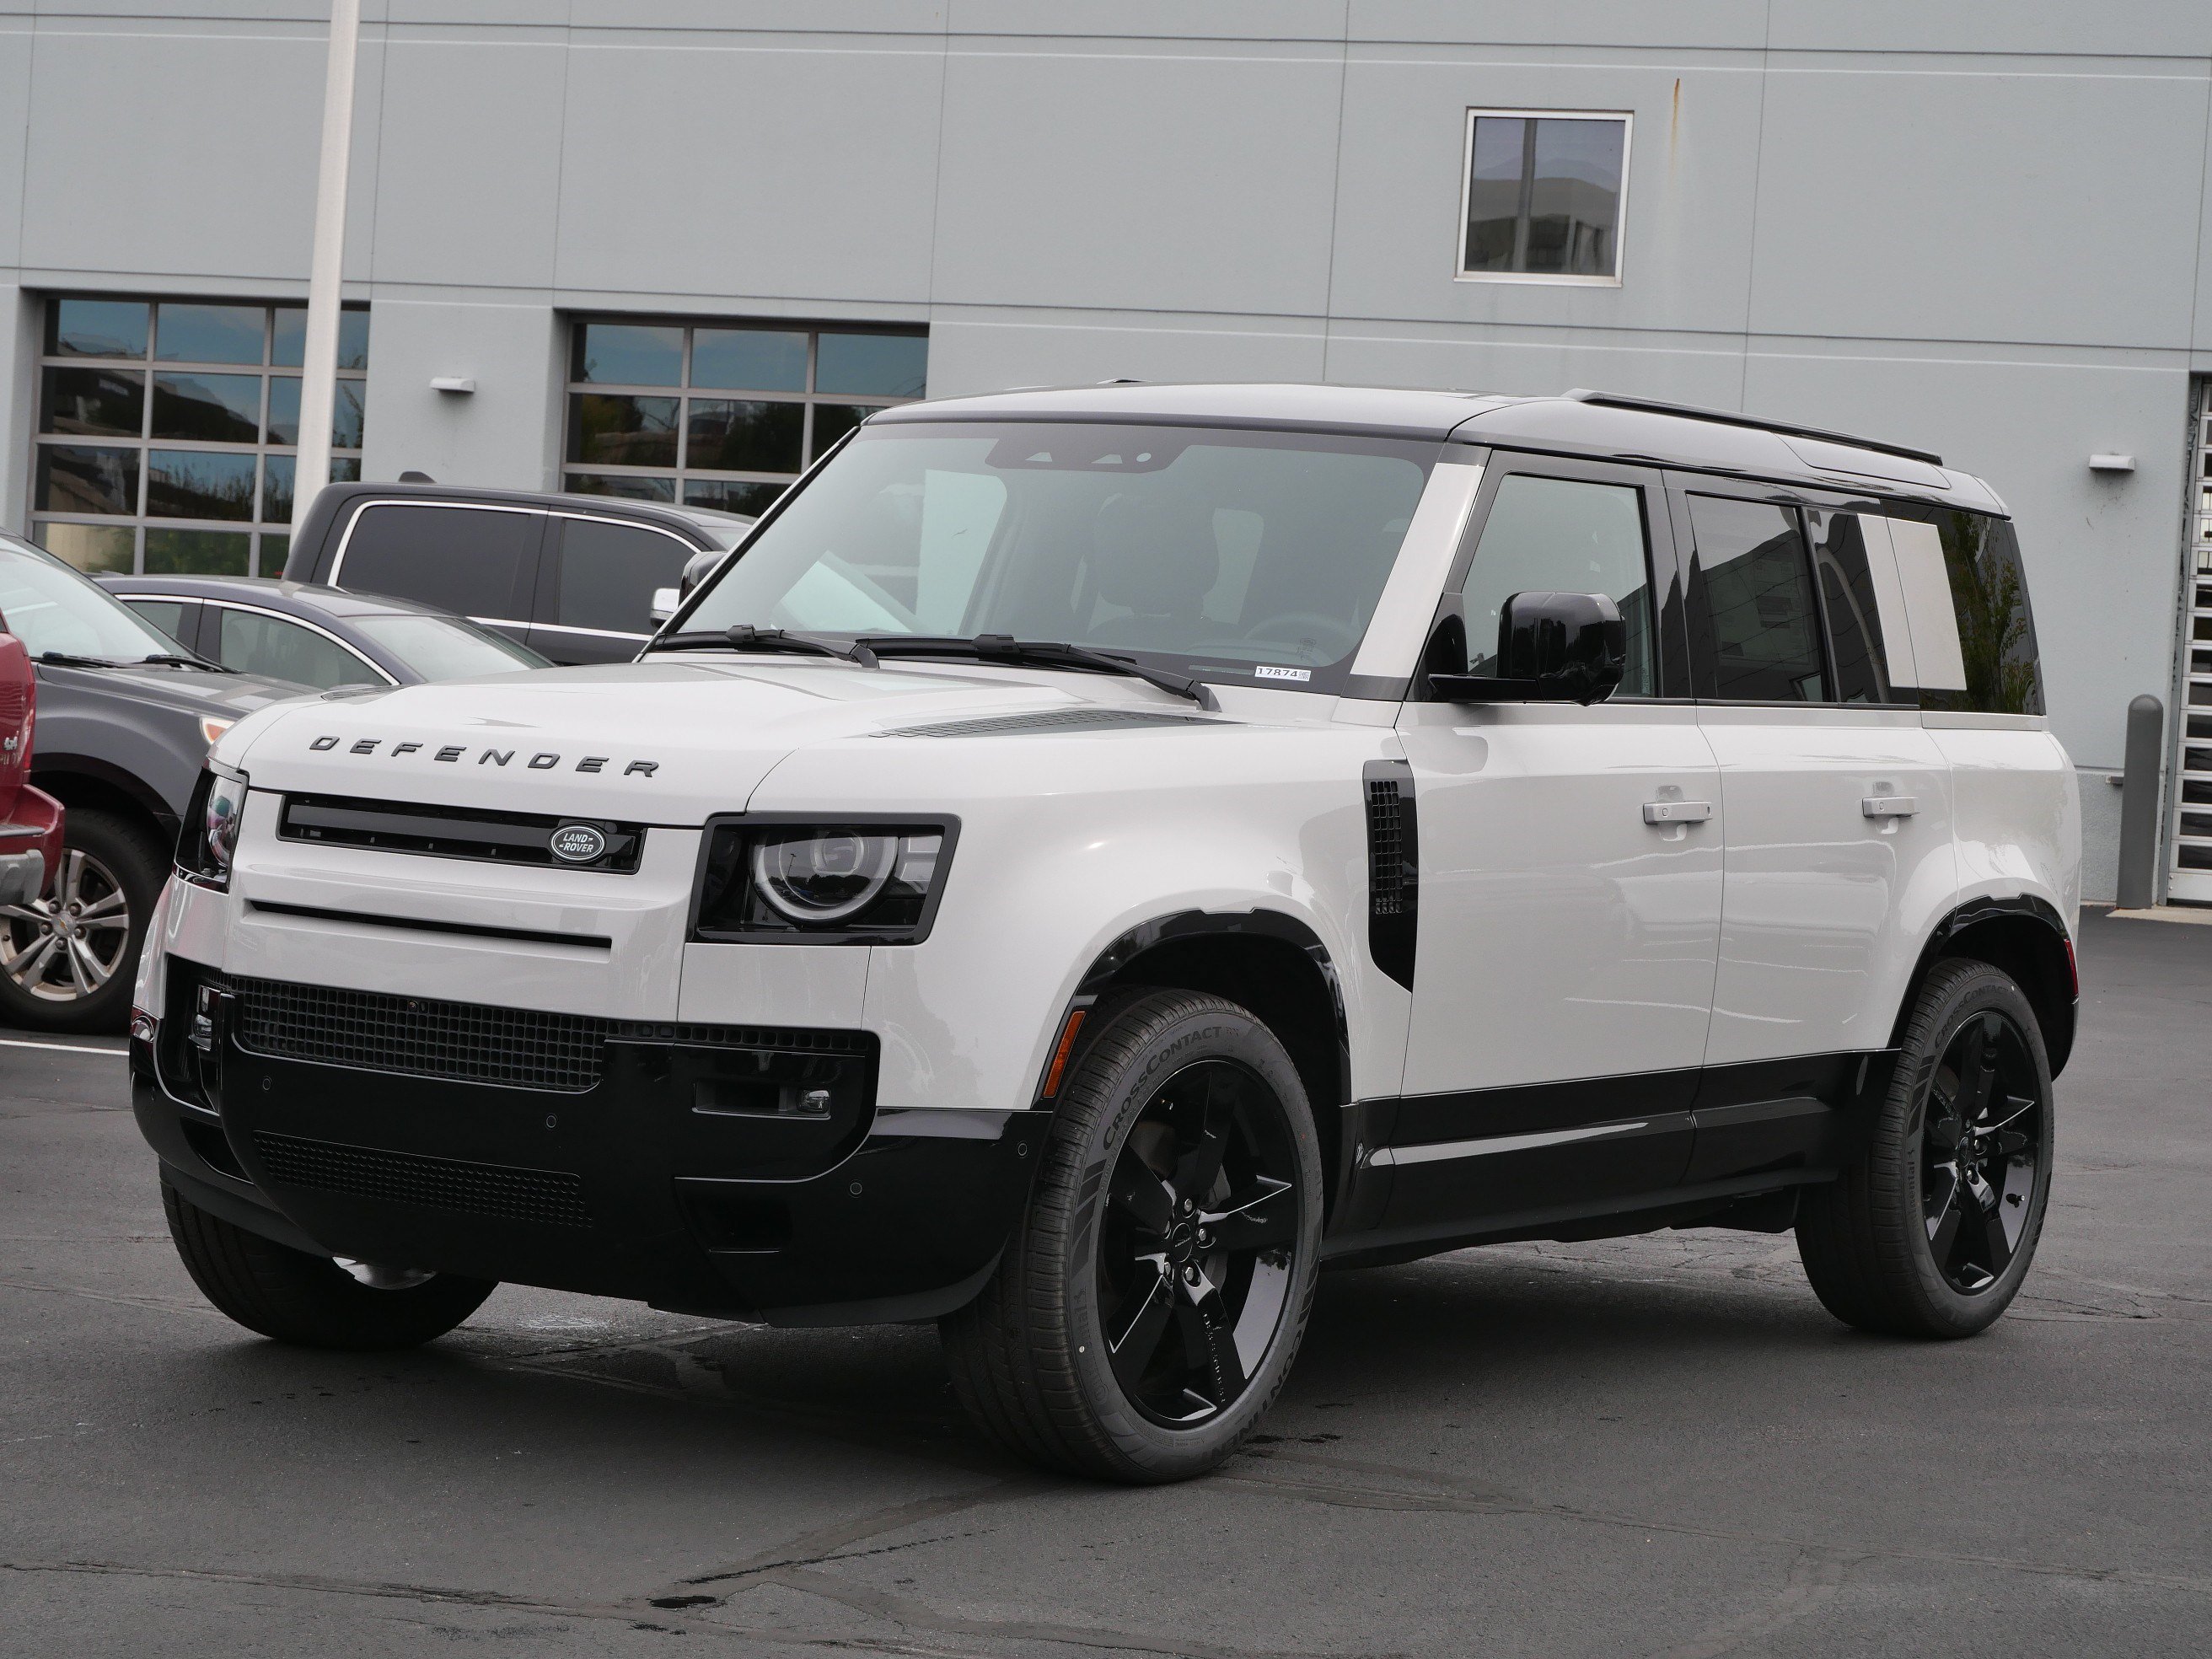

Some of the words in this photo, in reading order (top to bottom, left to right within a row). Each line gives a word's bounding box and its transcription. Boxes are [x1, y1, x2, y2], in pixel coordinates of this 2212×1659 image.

[1259, 668, 1298, 677] 17874
[309, 735, 659, 778] DEFENDER
[563, 833, 588, 843] LAND
[563, 843, 594, 853] ROVER
